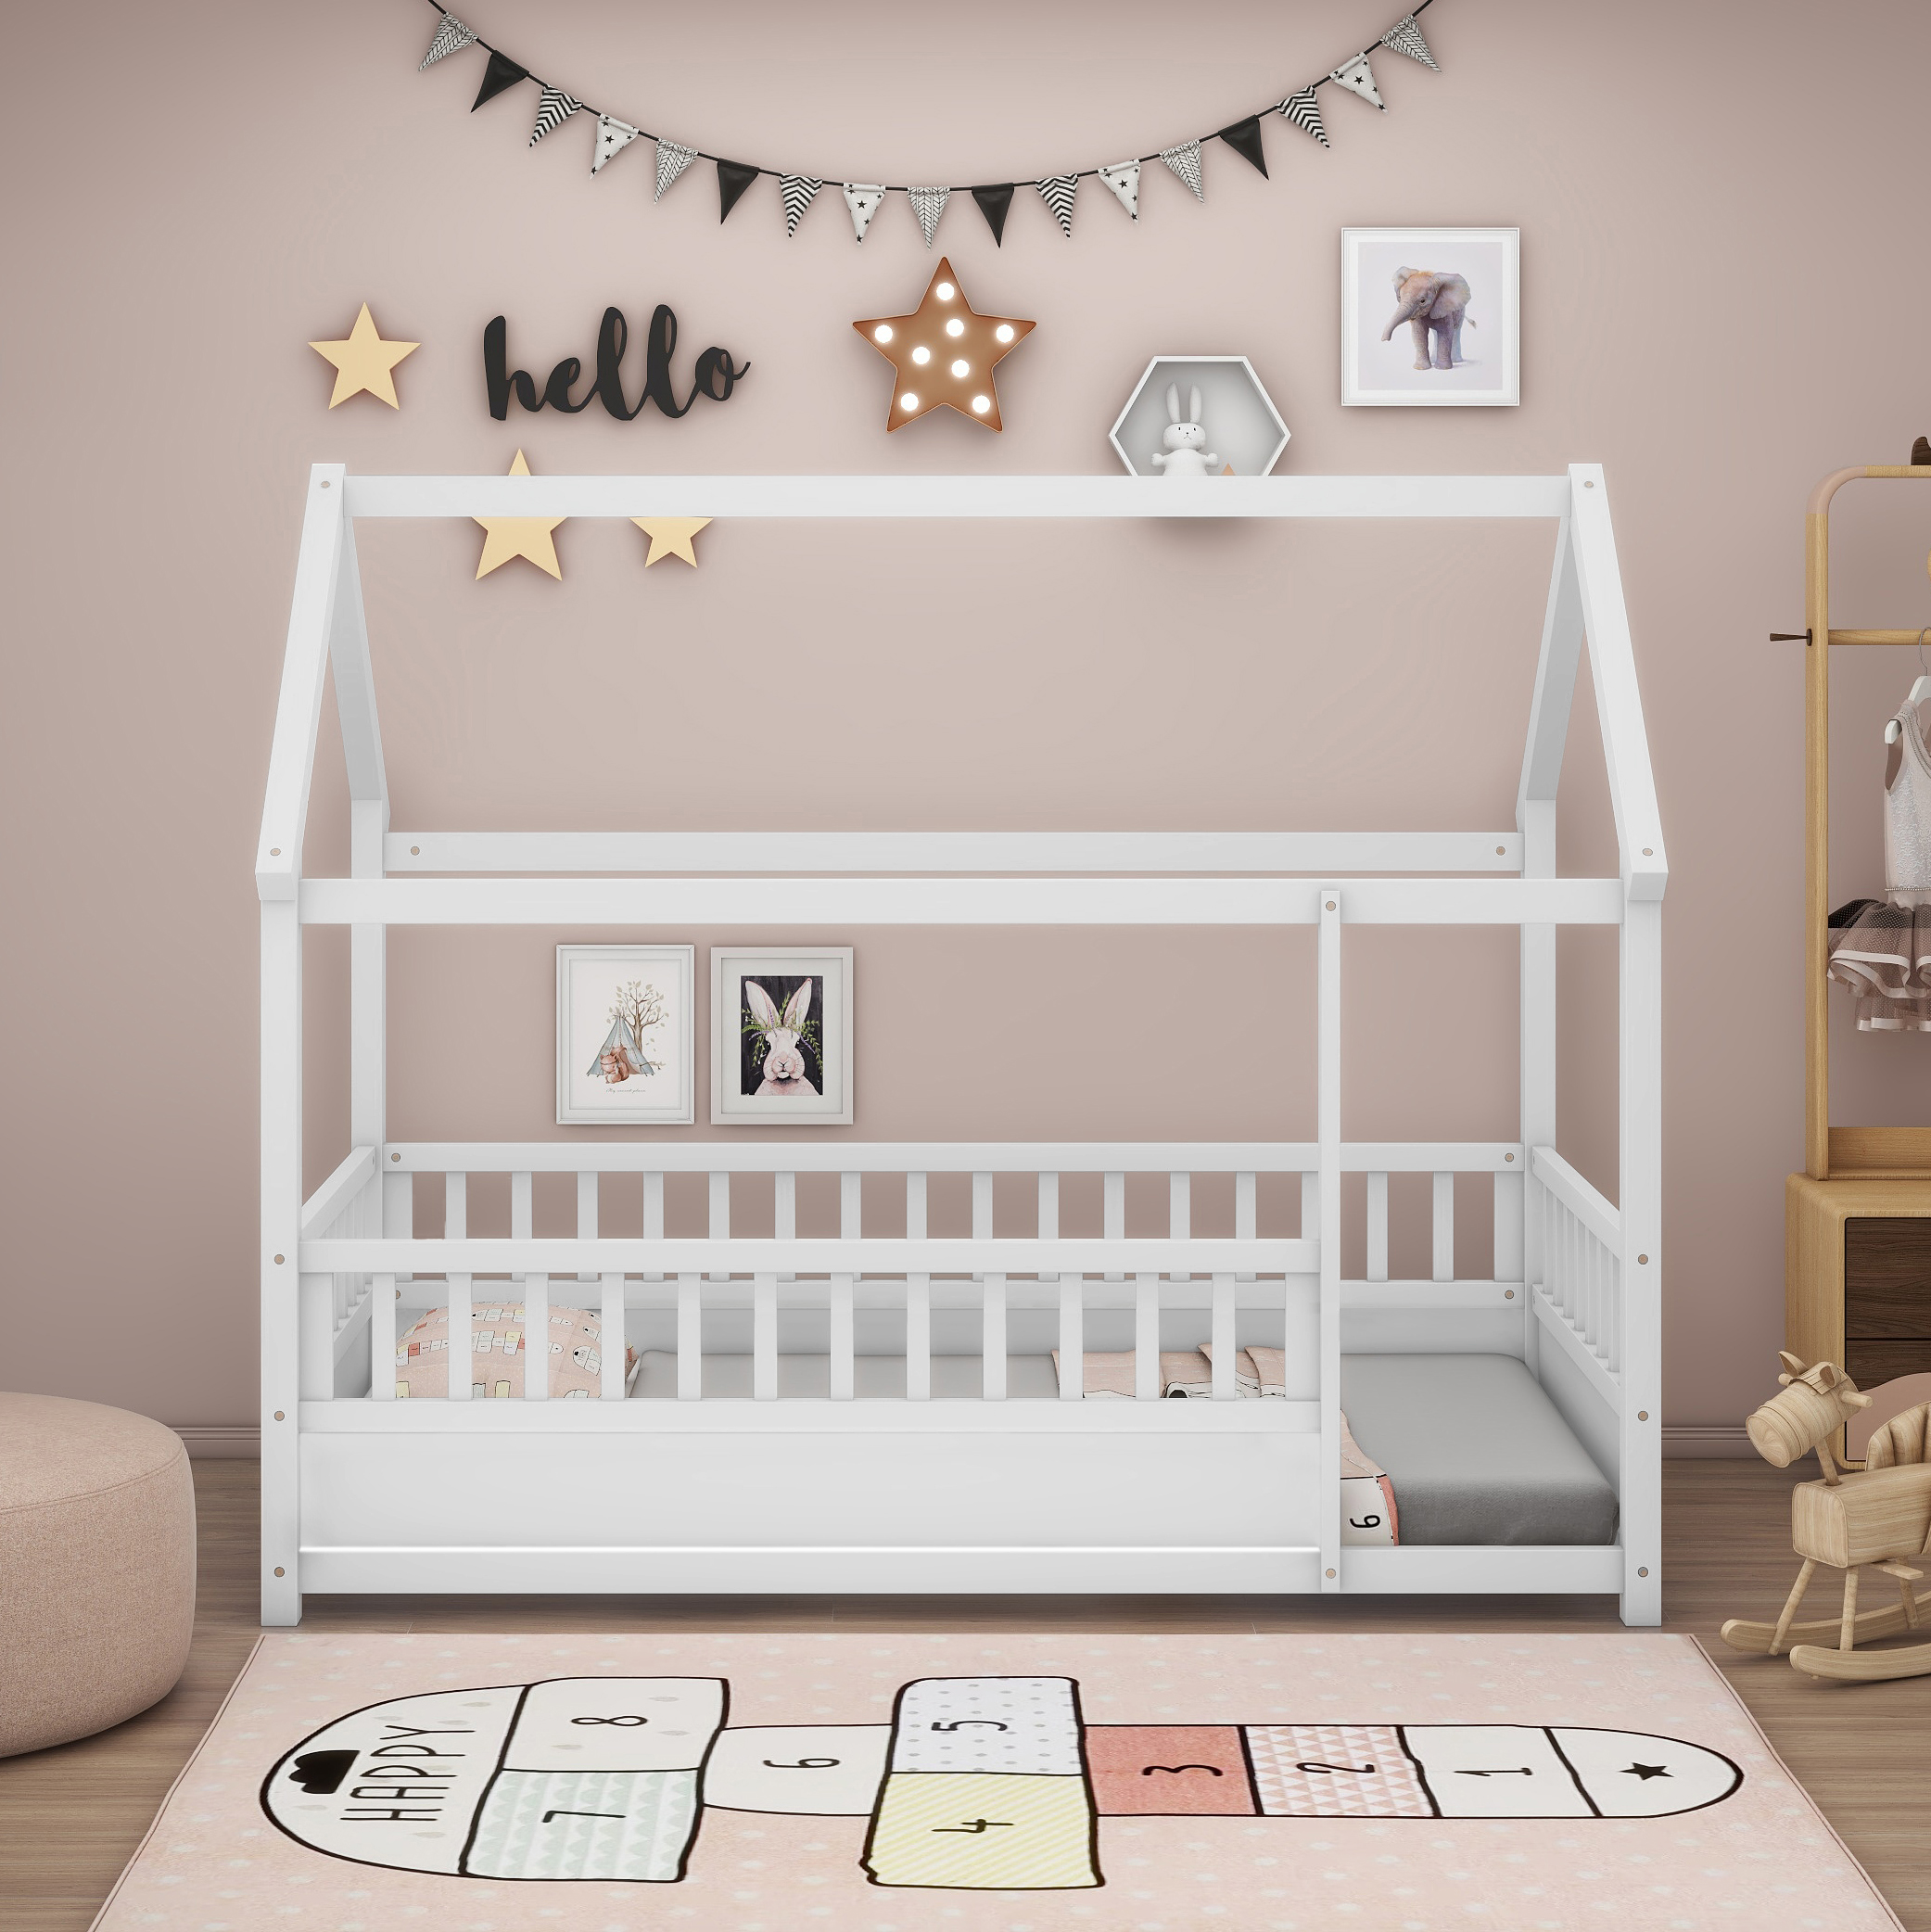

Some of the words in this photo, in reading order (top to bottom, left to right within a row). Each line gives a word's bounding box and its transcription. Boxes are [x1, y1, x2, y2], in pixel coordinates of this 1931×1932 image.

[483, 303, 752, 422] hello
[570, 1715, 649, 1727] 8
[931, 1720, 1009, 1732] 5
[762, 1757, 841, 1769] 6
[1296, 1761, 1376, 1774] 2
[339, 1724, 476, 1822] HAPPY
[1141, 1763, 1224, 1777] 3
[1454, 1767, 1532, 1777] 1
[541, 1810, 627, 1824] 7
[931, 1818, 1015, 1834] 4
